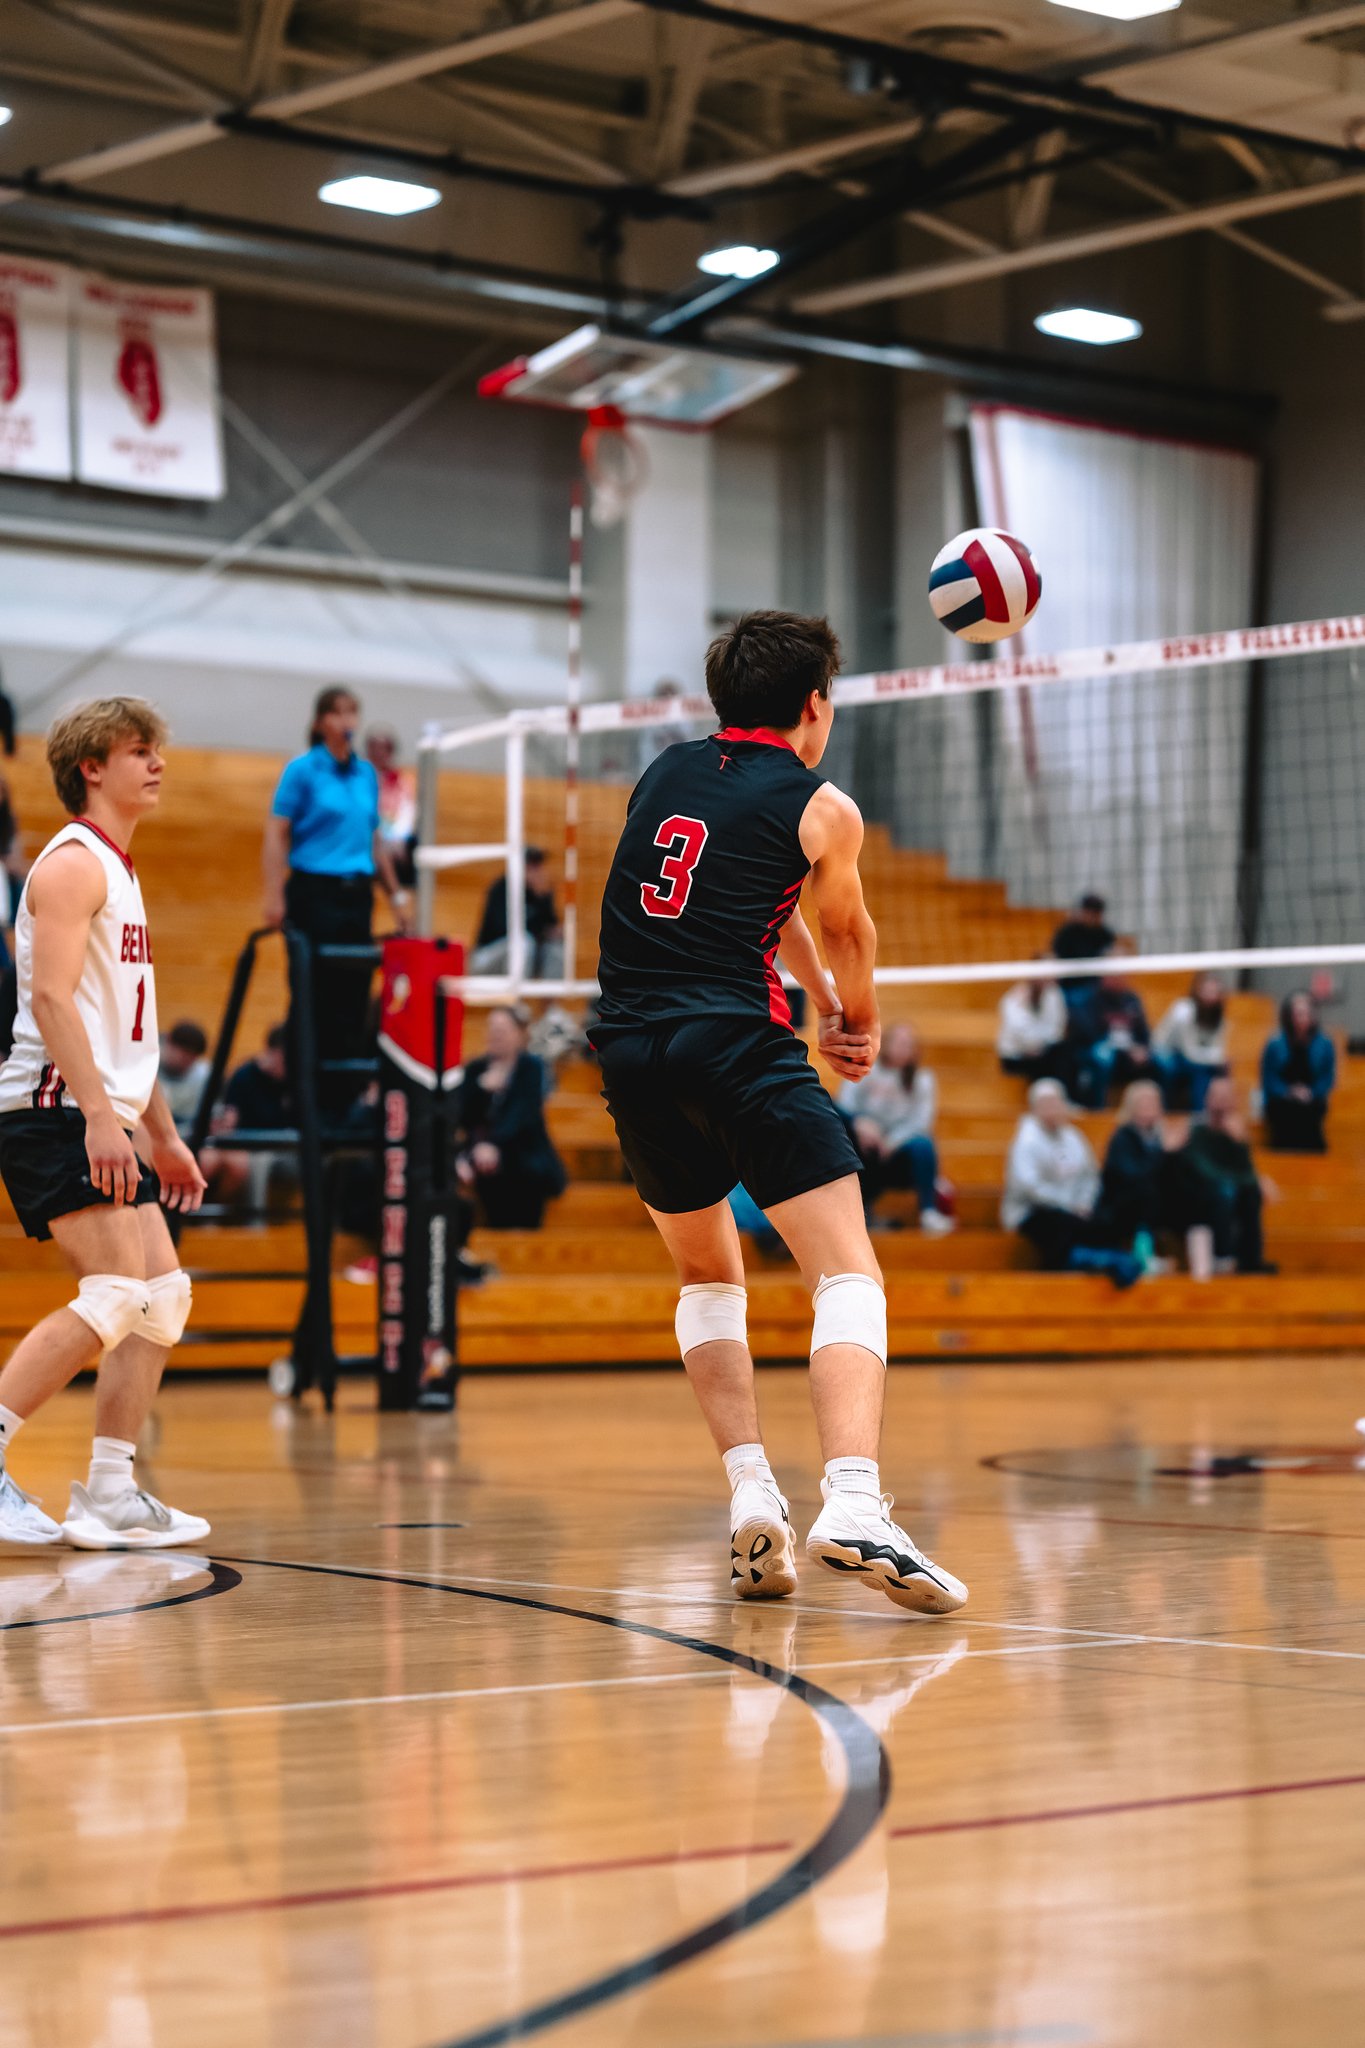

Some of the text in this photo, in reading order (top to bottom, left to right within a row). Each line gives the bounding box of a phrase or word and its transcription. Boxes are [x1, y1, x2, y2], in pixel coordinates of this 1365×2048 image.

[1239, 615, 1365, 649] VOLLEYBAL
[640, 814, 709, 919] 3
[131, 974, 145, 1042] 1
